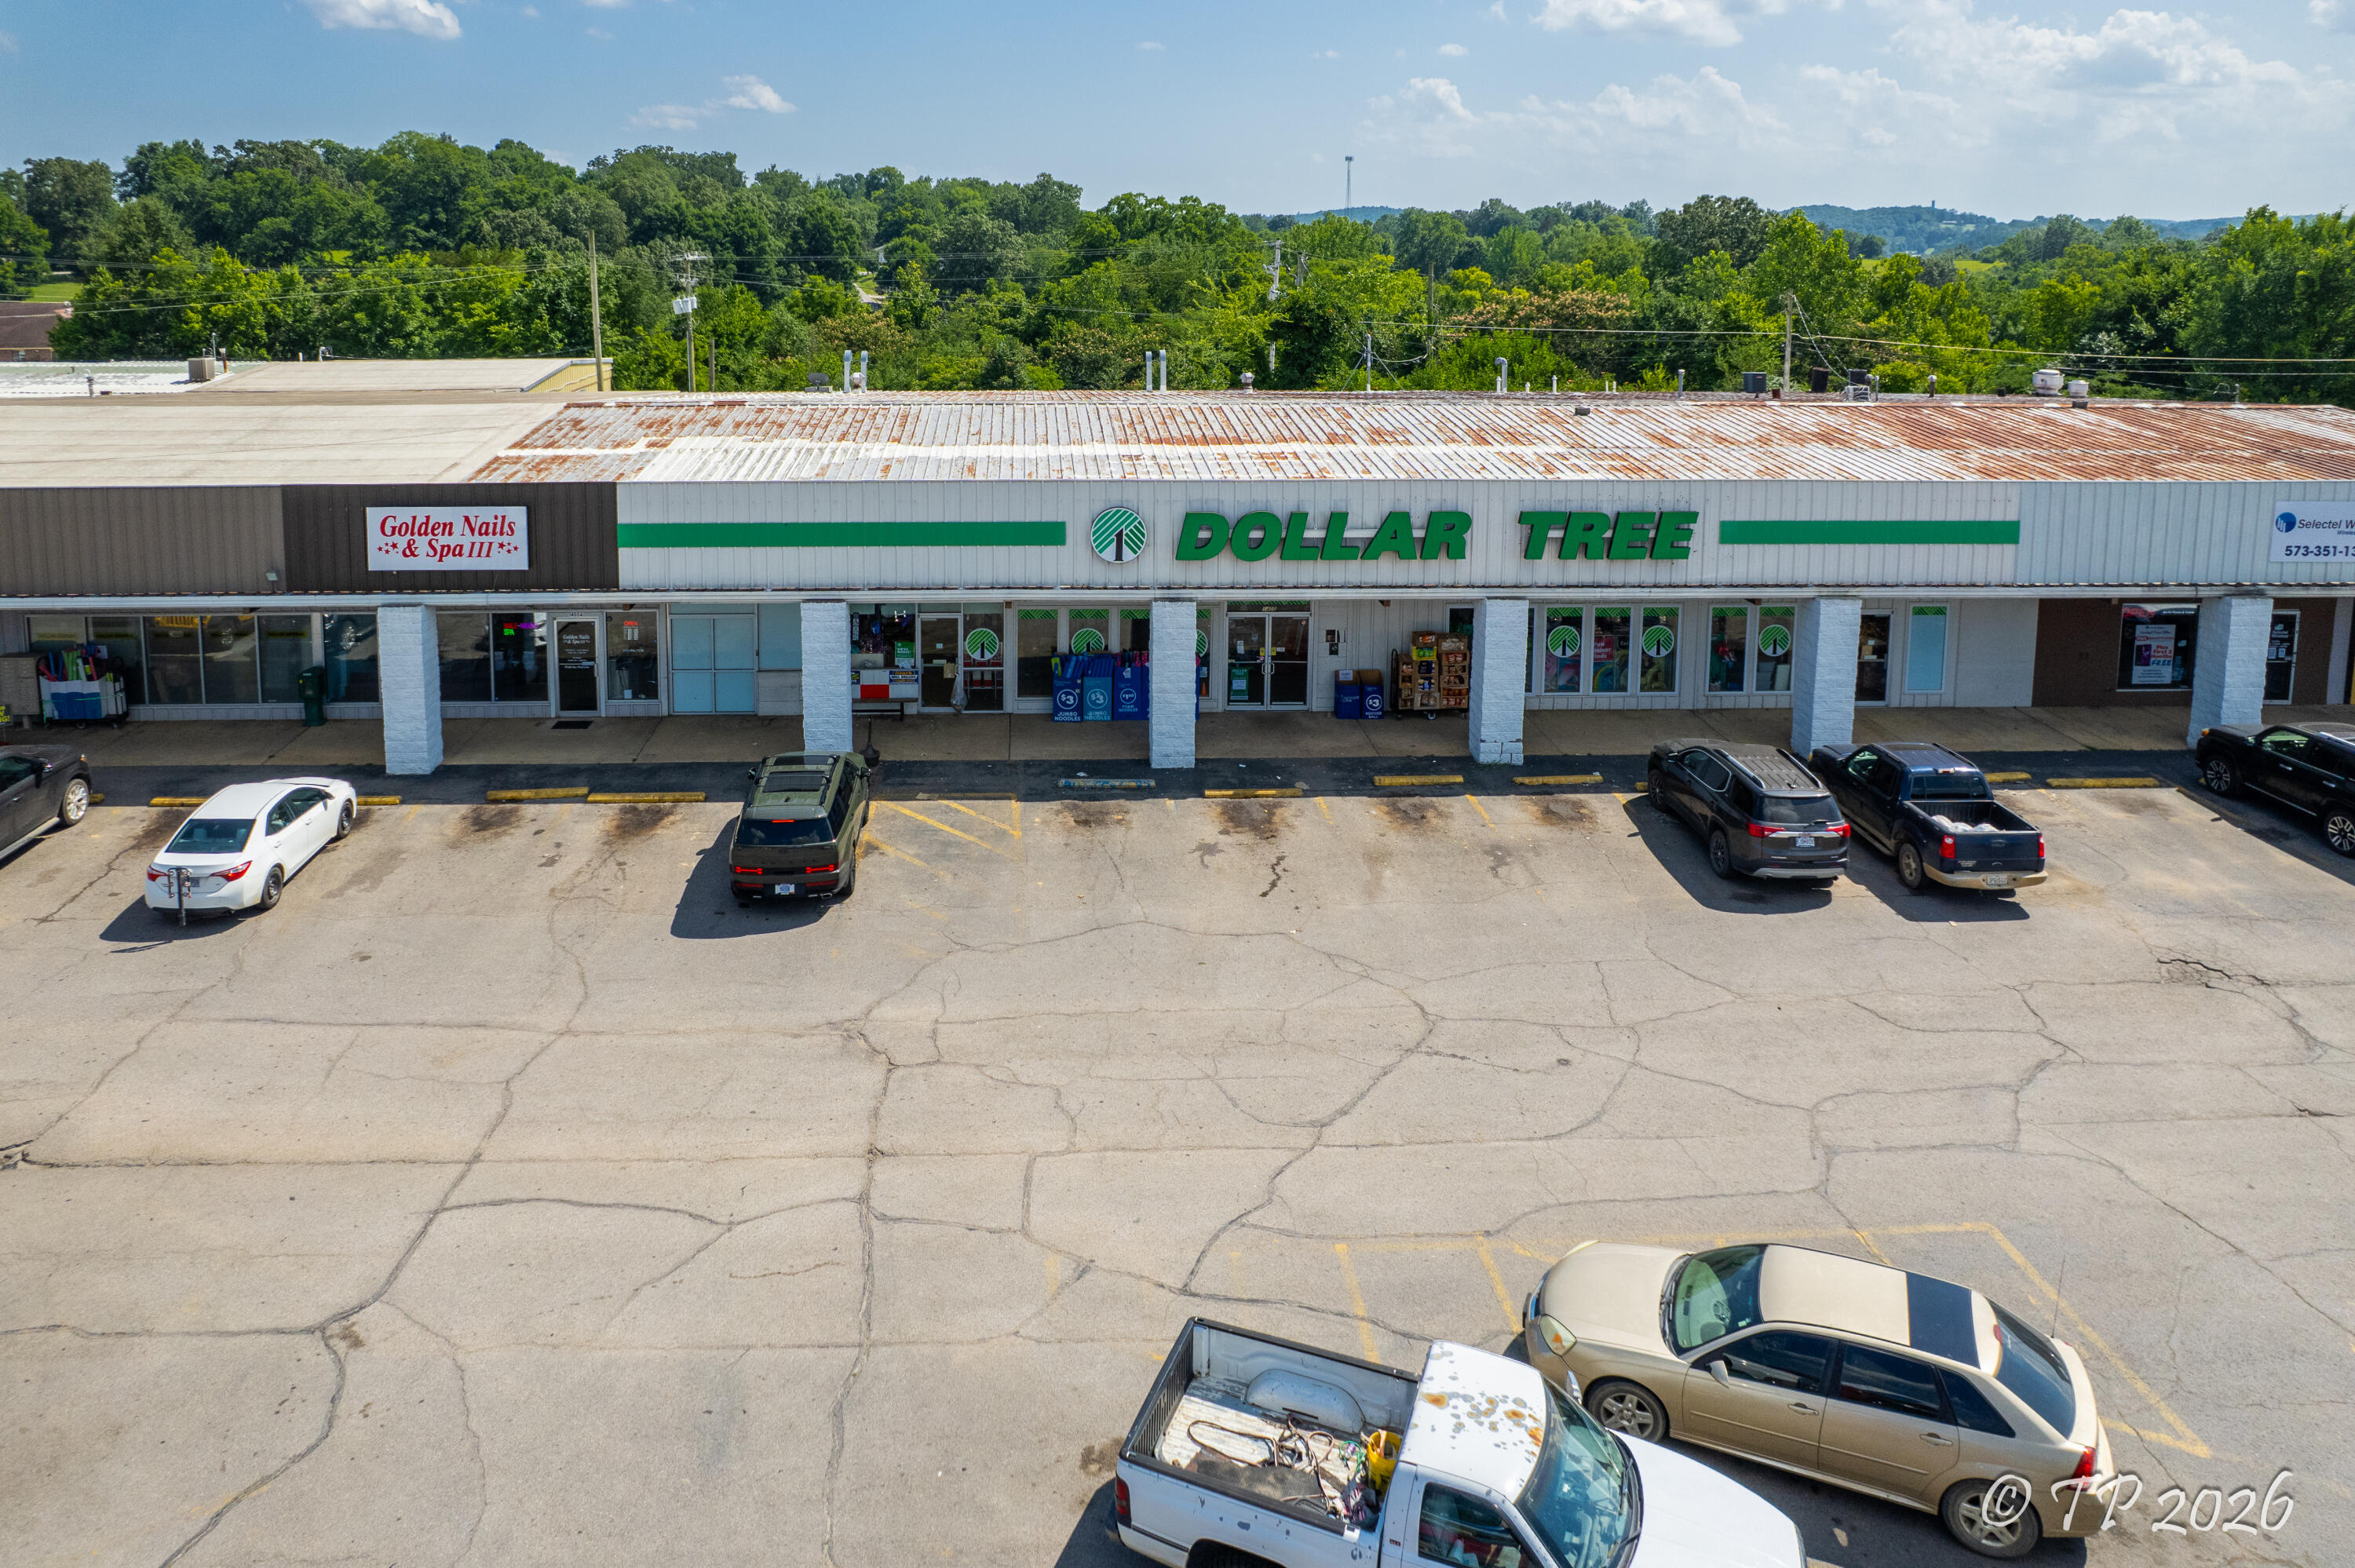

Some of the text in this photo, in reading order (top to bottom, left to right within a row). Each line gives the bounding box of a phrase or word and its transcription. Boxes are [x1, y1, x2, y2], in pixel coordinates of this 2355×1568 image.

[380, 514, 516, 537] Golden Nails
[2298, 519, 2342, 529] Selectel
[1176, 510, 1699, 562] DOLLAR TREE
[401, 538, 495, 563] & Spa III
[1061, 693, 1074, 705] $3
[1368, 698, 1380, 707] $3
